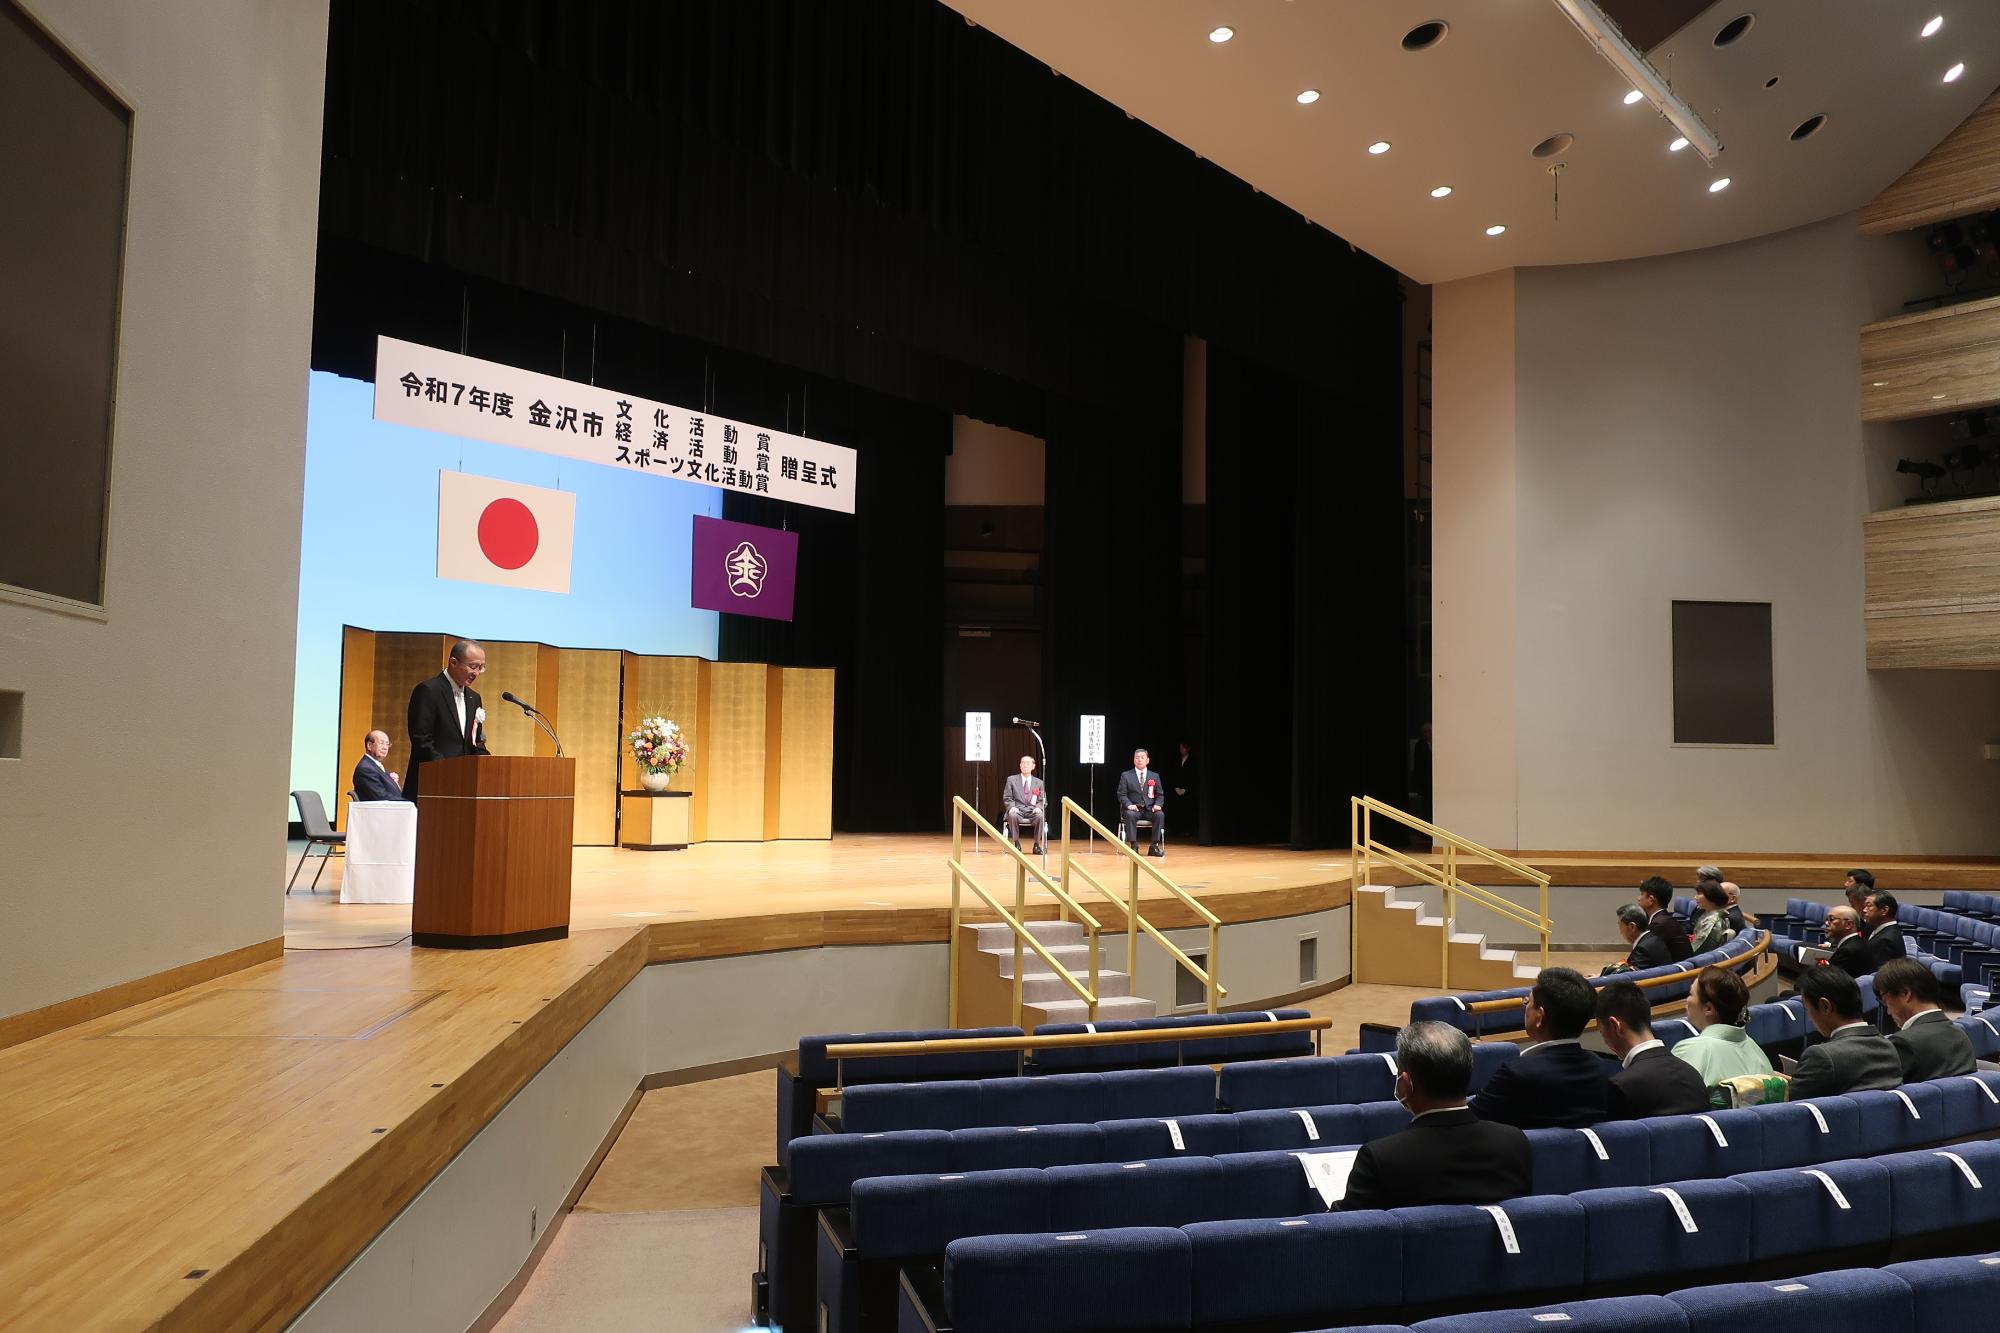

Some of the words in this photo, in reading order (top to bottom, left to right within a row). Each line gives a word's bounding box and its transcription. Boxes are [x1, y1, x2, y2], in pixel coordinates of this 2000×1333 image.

[399, 371, 514, 419] 令和7年度
[529, 400, 604, 438] 金沢市
[616, 399, 771, 453] 文化活動賞
[615, 421, 770, 473] 経済活動賞
[616, 445, 770, 493] スポーツ文化活動賞
[781, 455, 837, 489] 贈呈式
